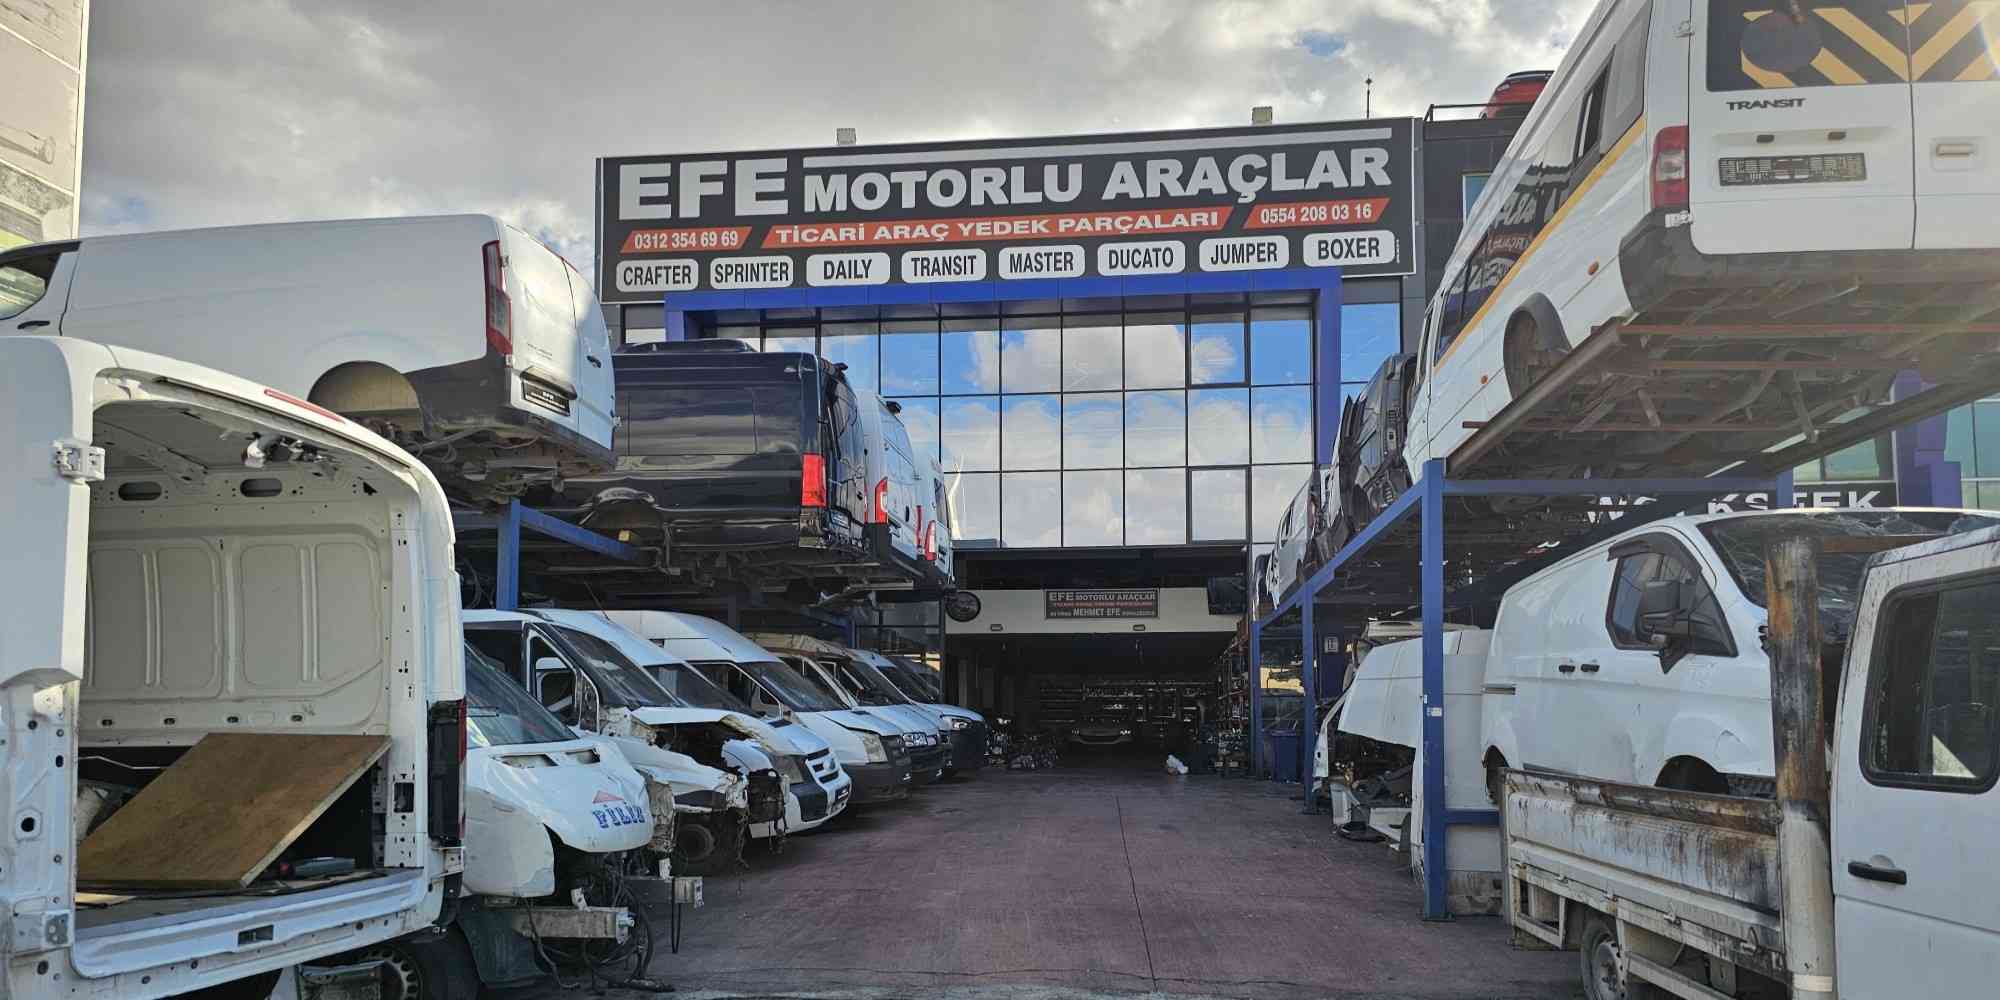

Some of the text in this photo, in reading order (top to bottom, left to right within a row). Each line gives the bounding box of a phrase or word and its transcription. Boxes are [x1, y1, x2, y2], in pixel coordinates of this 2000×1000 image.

[1726, 98, 1806, 111] TRANSIT
[618, 147, 1392, 220] EFE MOTORLU ARAÇLAR
[1260, 203, 1372, 224] 0554 208 03 16
[775, 212, 1218, 243] TİCARİ ARAÇ YEDEK PARÇALARI
[634, 230, 739, 249] 0312 354 69 69
[1317, 238, 1380, 260] BOXER
[1009, 252, 1074, 273] MASTER
[1108, 247, 1174, 269] DUCATO
[1210, 242, 1278, 265] JUMPER
[623, 265, 692, 286] CRAFTER
[714, 263, 789, 284] SPRINTER
[823, 259, 873, 280] DAILY
[911, 255, 977, 278] TRANSIT
[1049, 592, 1074, 601] EFE
[1107, 608, 1121, 616] EFE
